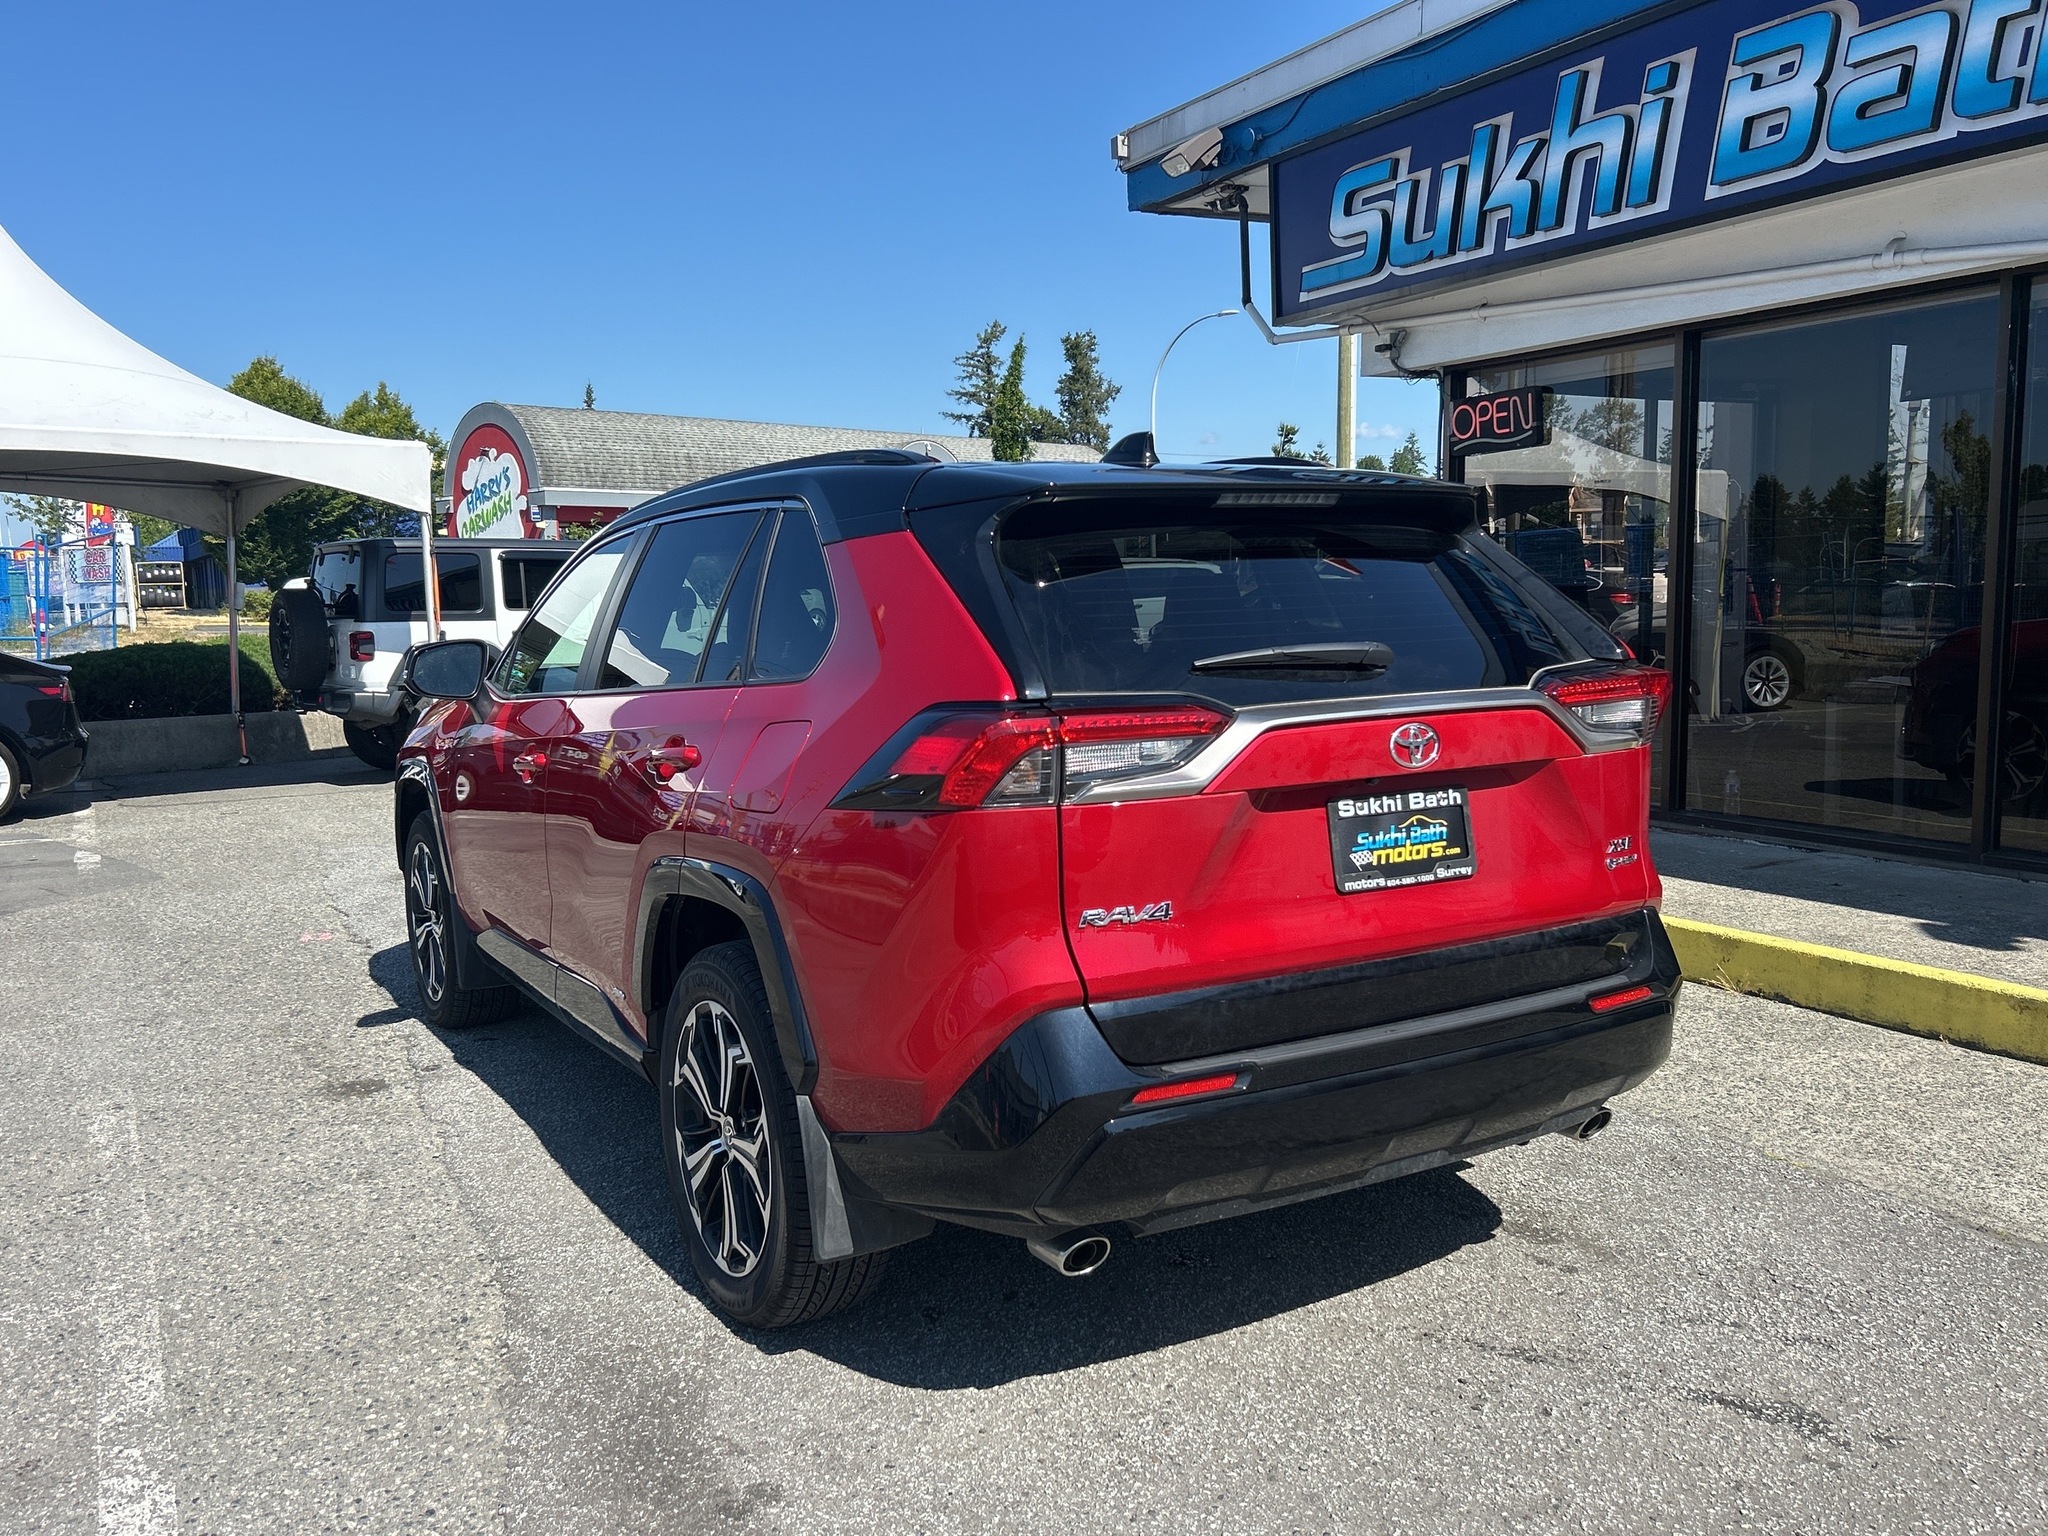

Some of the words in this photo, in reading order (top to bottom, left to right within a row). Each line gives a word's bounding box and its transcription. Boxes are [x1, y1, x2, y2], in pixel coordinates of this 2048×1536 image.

[1299, 52, 1692, 298] Sukhi
[1708, 0, 2048, 193] Bat
[1452, 392, 1534, 439] OPEN
[466, 466, 511, 515] HARRY'S
[85, 549, 106, 565] CAR
[81, 565, 111, 582] WASH
[1337, 794, 1403, 817] Sukhi
[1408, 789, 1462, 810] Bath
[1351, 825, 1406, 851] Sukhi
[1410, 823, 1448, 844] Bath
[1344, 876, 1386, 891] motors
[1436, 865, 1472, 880] Surrey
[1078, 900, 1174, 929] RAV4
